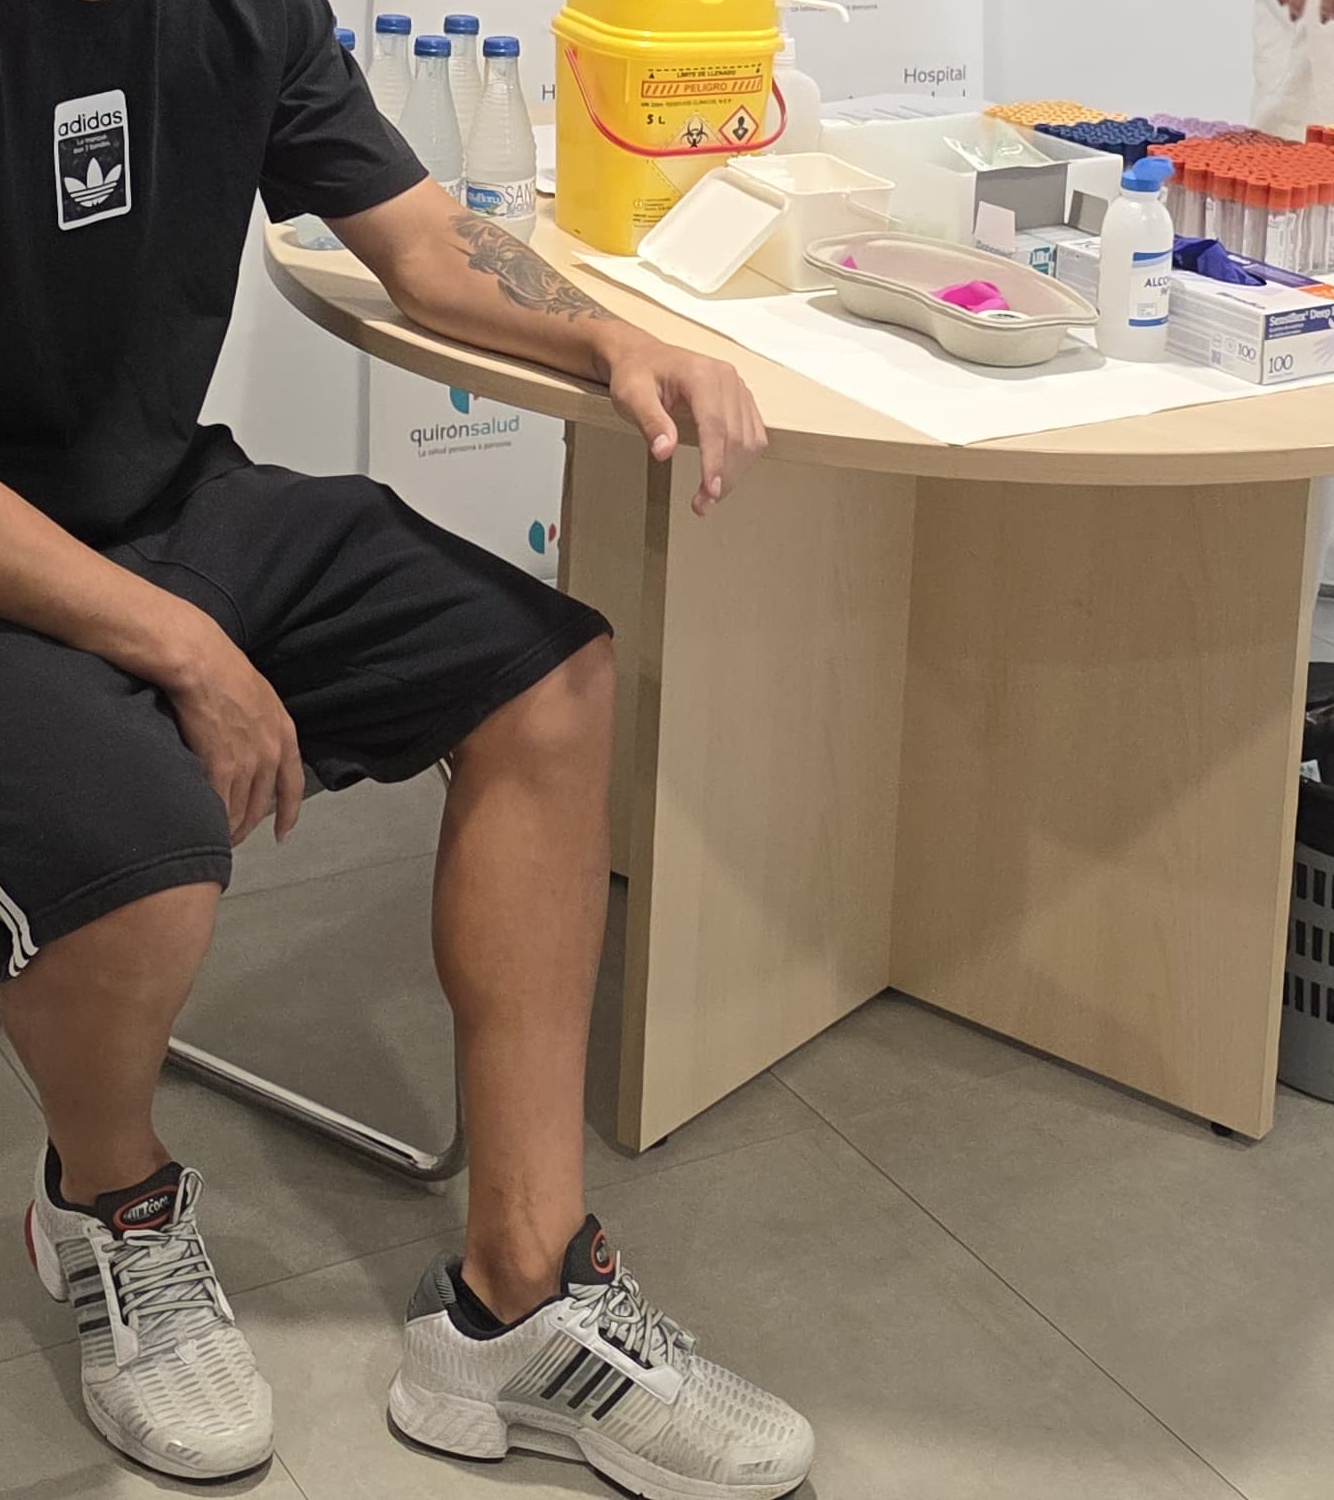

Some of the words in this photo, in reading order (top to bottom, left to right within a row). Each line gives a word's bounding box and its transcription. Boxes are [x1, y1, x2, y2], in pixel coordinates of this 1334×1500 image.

[904, 65, 966, 86] Hospital
[684, 83, 727, 92] PELIGRO
[58, 110, 123, 137] adidas
[1268, 354, 1293, 374] 100
[410, 416, 519, 447] quirónsalud
